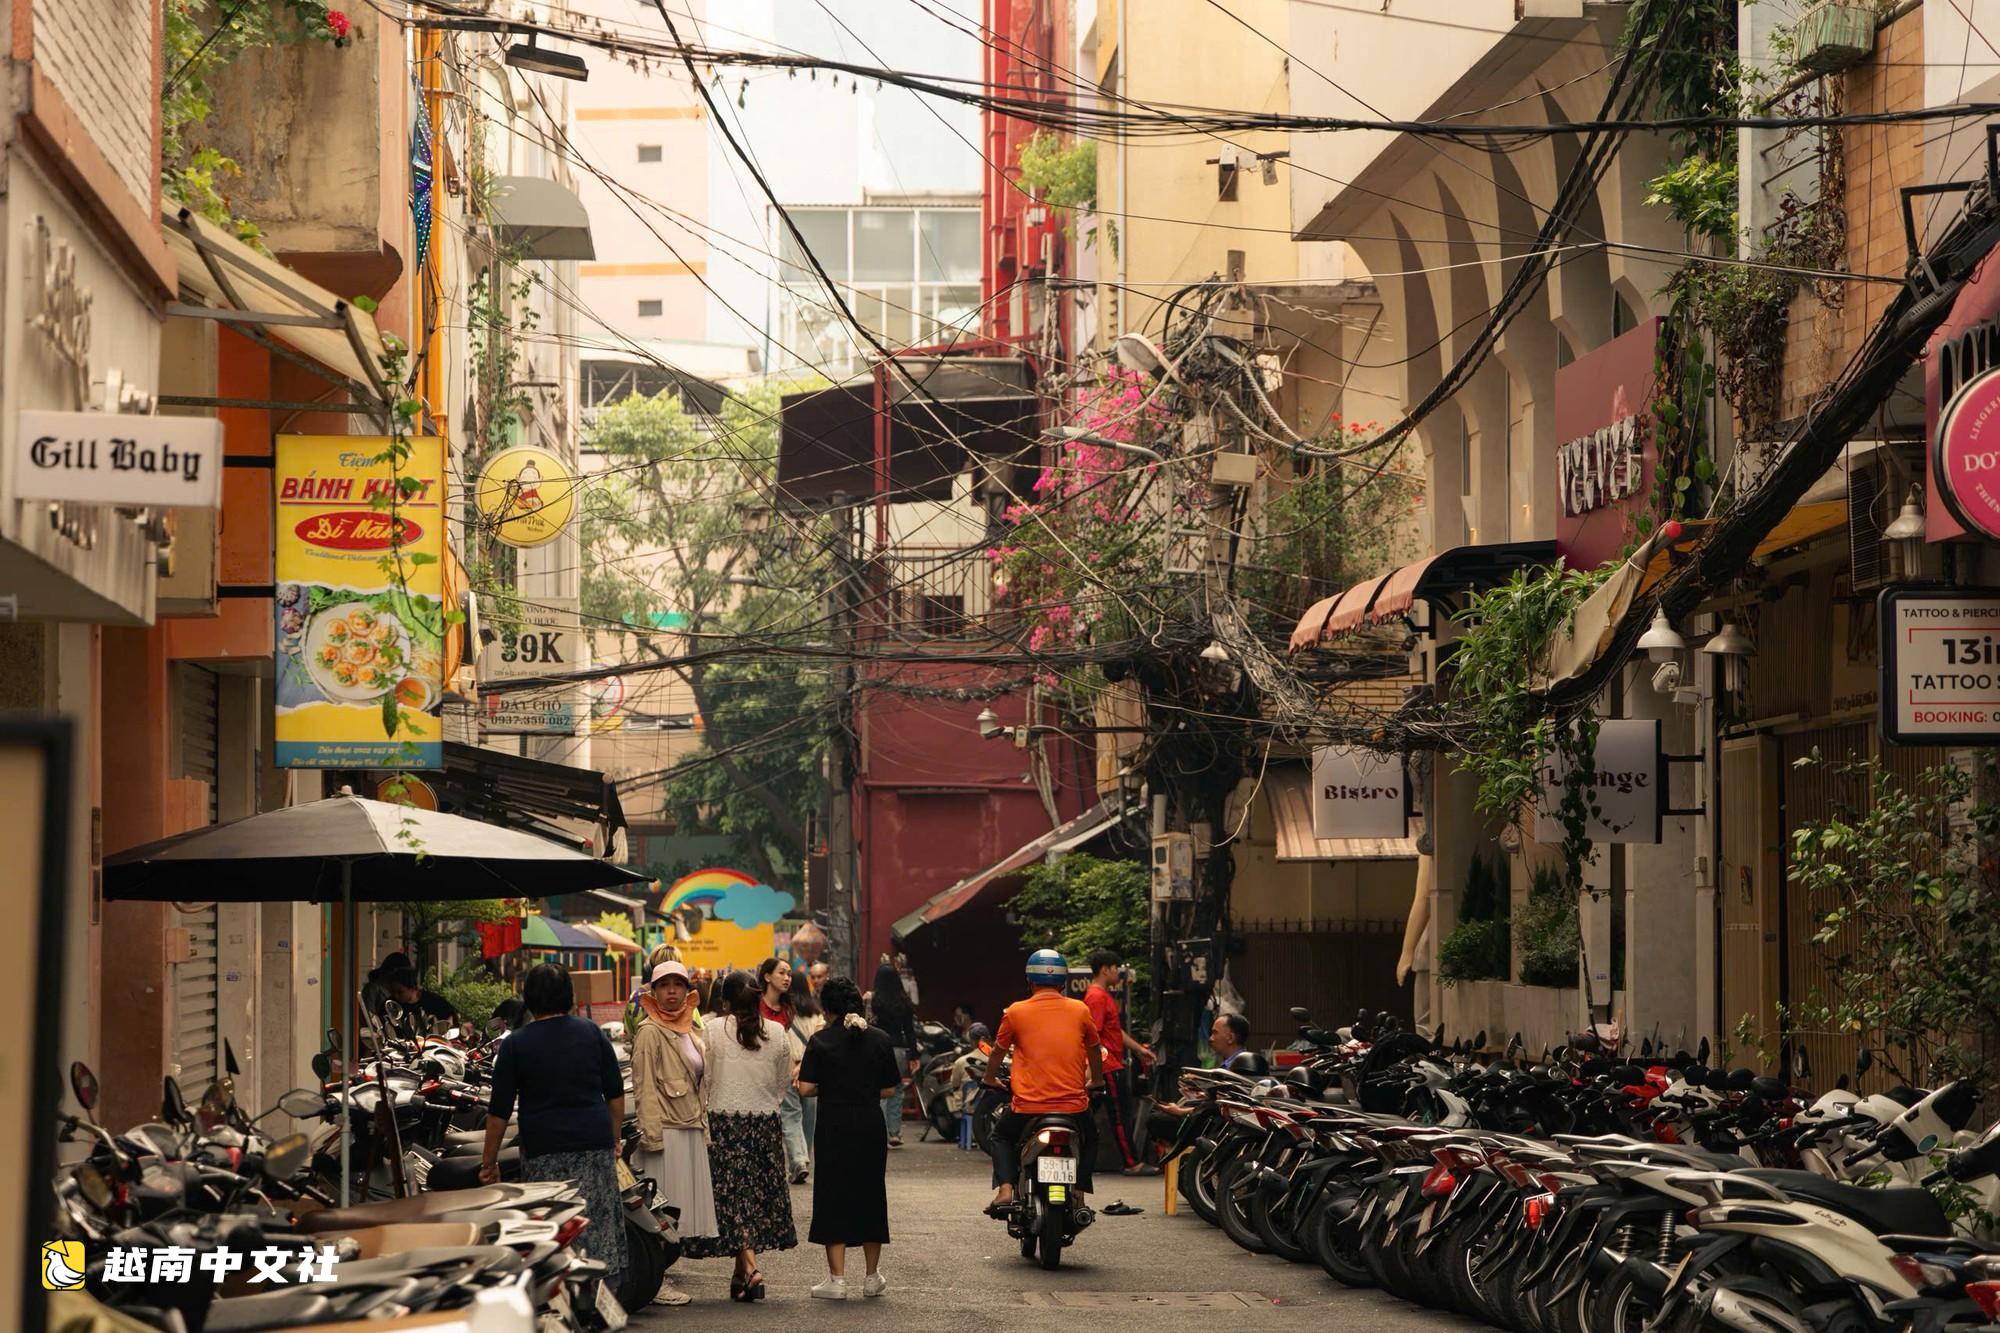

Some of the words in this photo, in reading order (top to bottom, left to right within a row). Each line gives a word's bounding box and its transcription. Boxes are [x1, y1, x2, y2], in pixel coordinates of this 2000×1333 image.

[30, 436, 98, 469] Gill
[109, 438, 201, 482] Baby
[280, 470, 355, 500] BÁNH
[1903, 608, 1949, 618] TATTOO
[1952, 608, 1960, 618] &
[1911, 674, 1991, 690] TATTOO
[1914, 711, 1987, 723] BOOKING:
[1548, 768, 1649, 794] Lnge
[1324, 784, 1399, 800] Bistro
